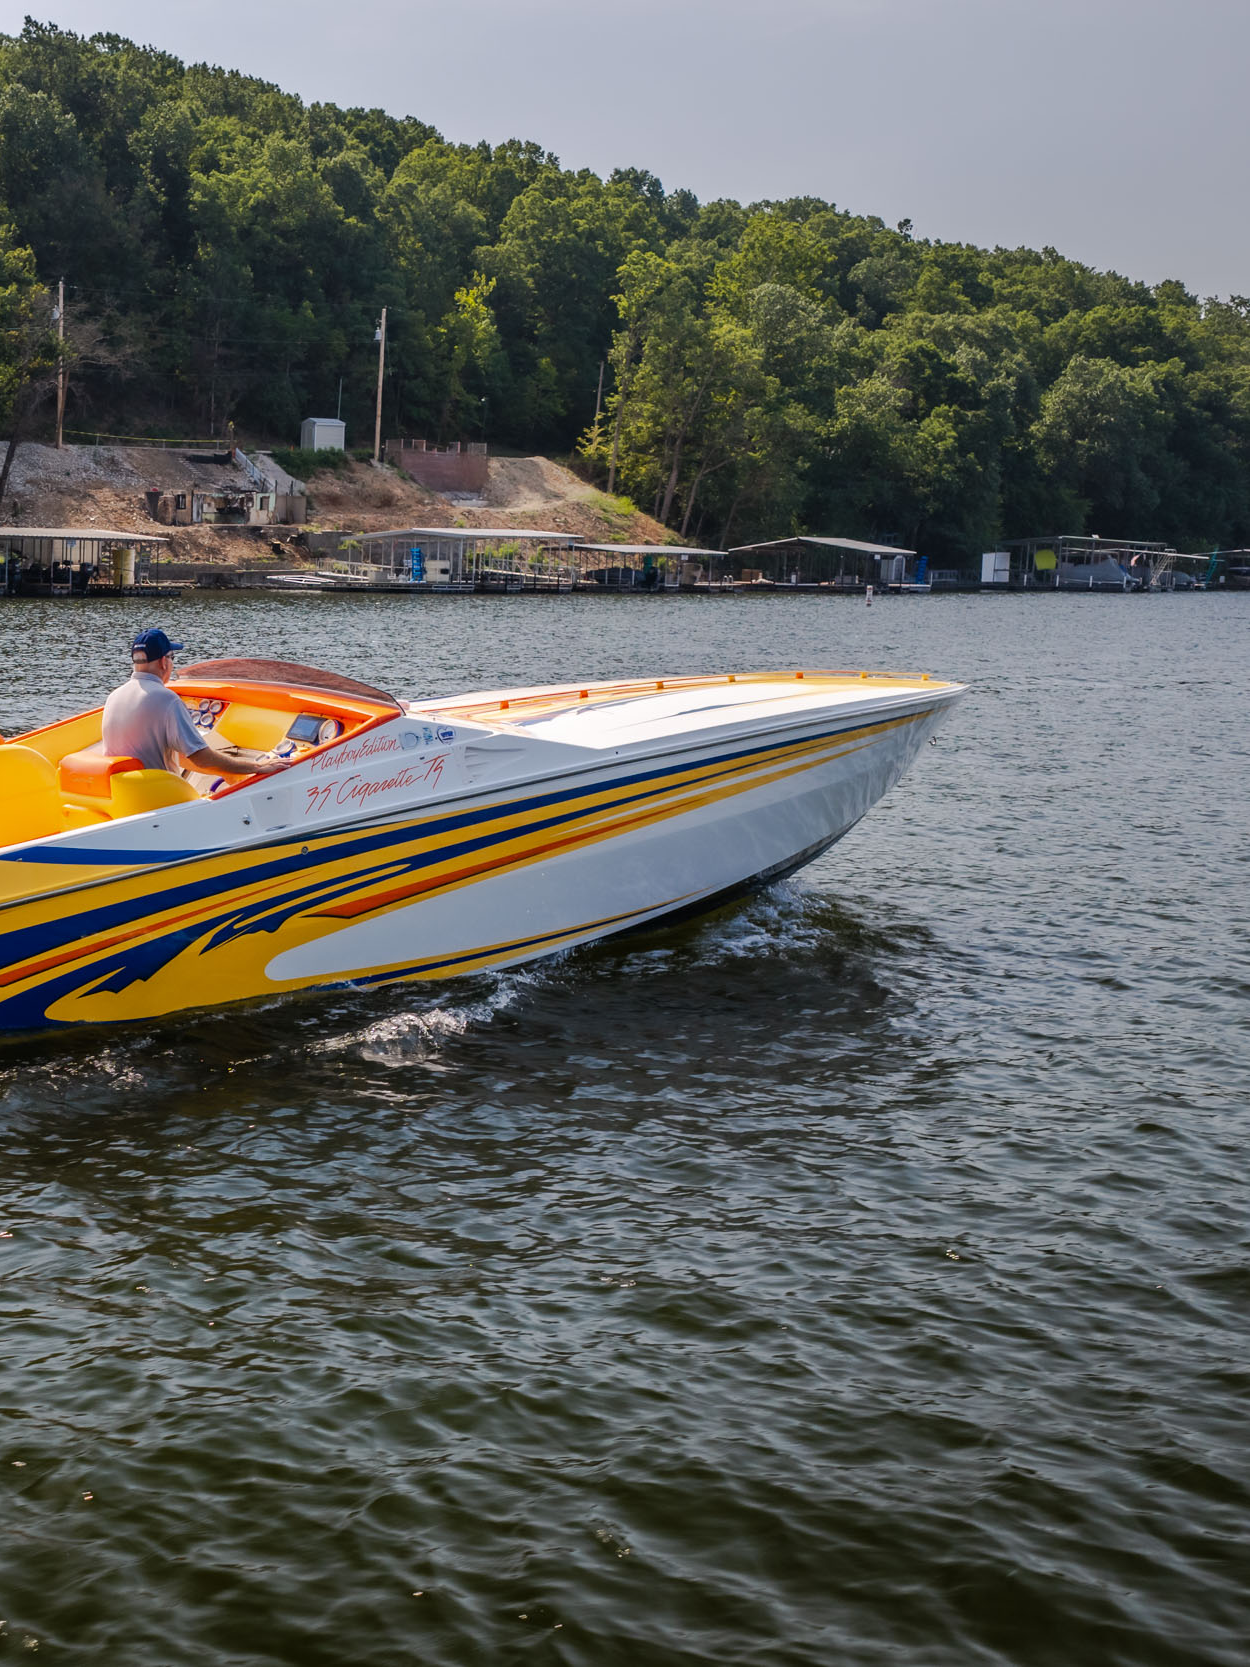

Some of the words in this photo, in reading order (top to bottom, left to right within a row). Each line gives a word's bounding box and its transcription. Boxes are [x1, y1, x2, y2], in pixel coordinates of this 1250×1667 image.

[311, 744, 360, 773] Playboy
[358, 735, 400, 758] Edition
[305, 781, 338, 815] 35
[337, 765, 424, 807] Cigarette
